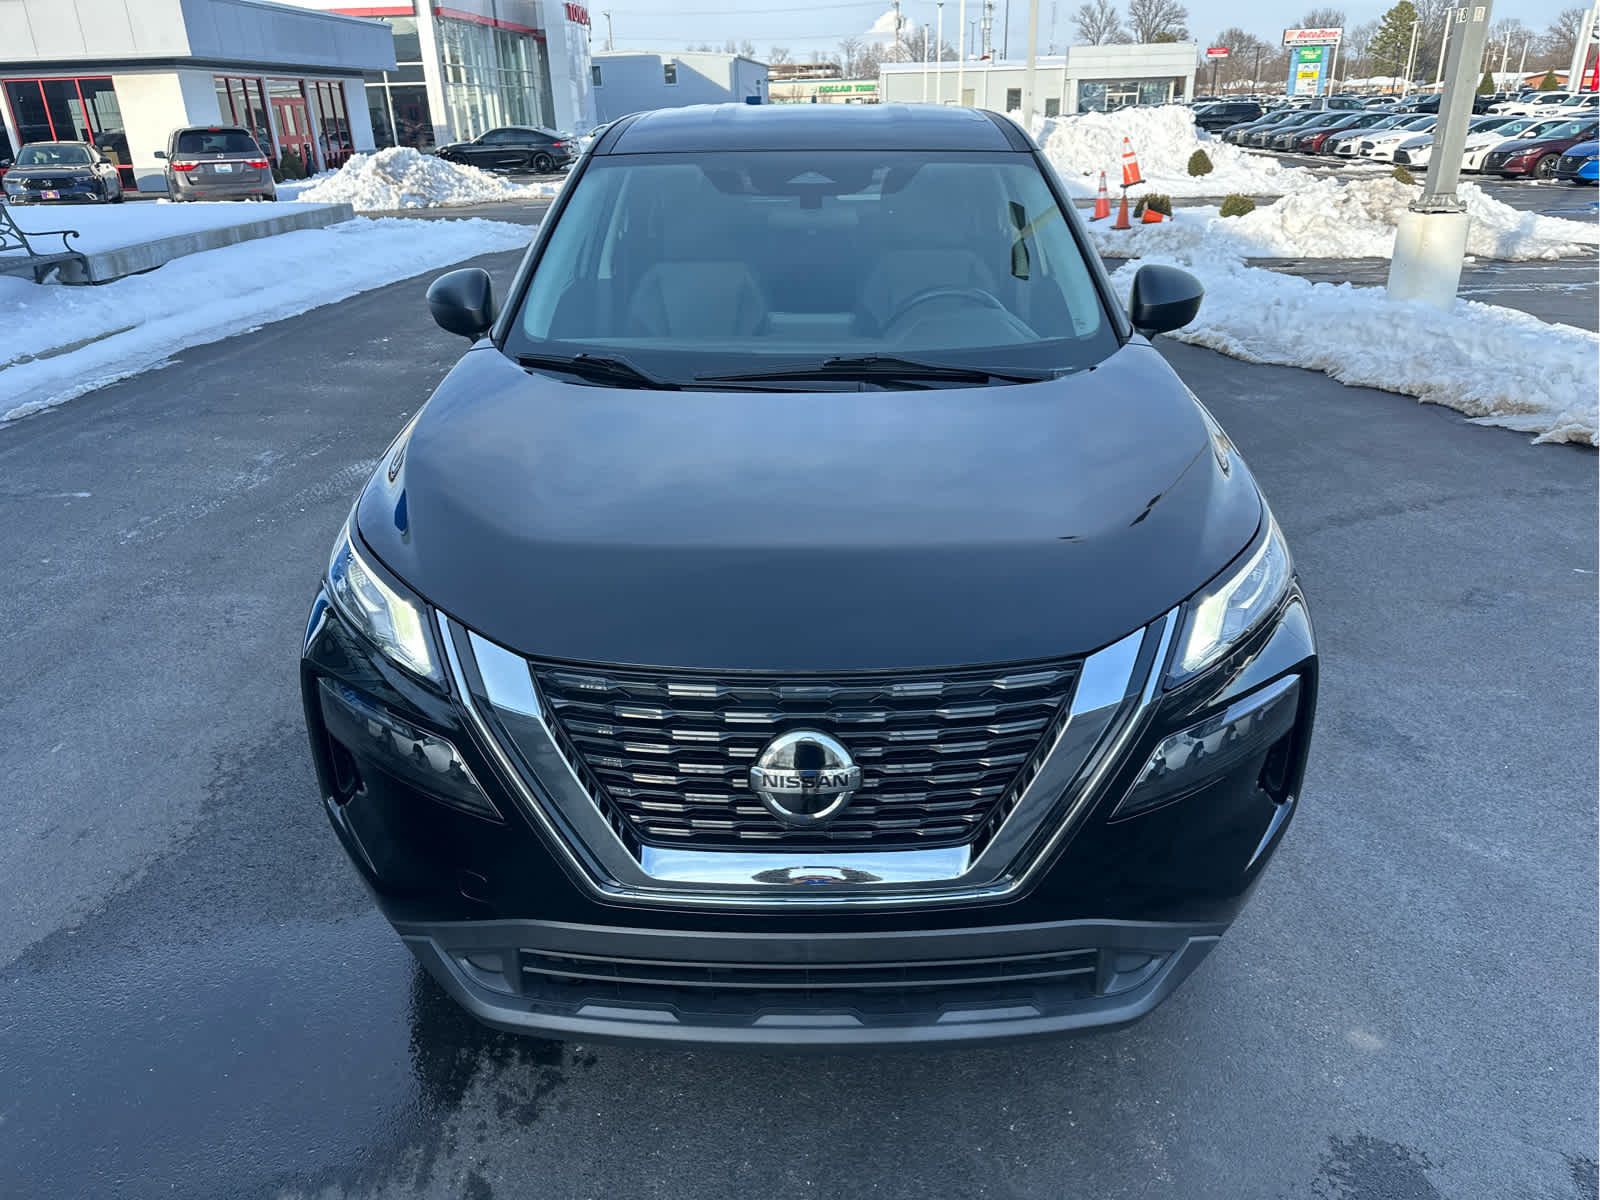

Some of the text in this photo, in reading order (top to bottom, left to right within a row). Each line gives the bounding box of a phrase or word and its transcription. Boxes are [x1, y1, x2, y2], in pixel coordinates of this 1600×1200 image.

[1297, 29, 1338, 38] AutoZone
[819, 85, 851, 93] DOLLAR
[762, 774, 849, 788] NISSAN
